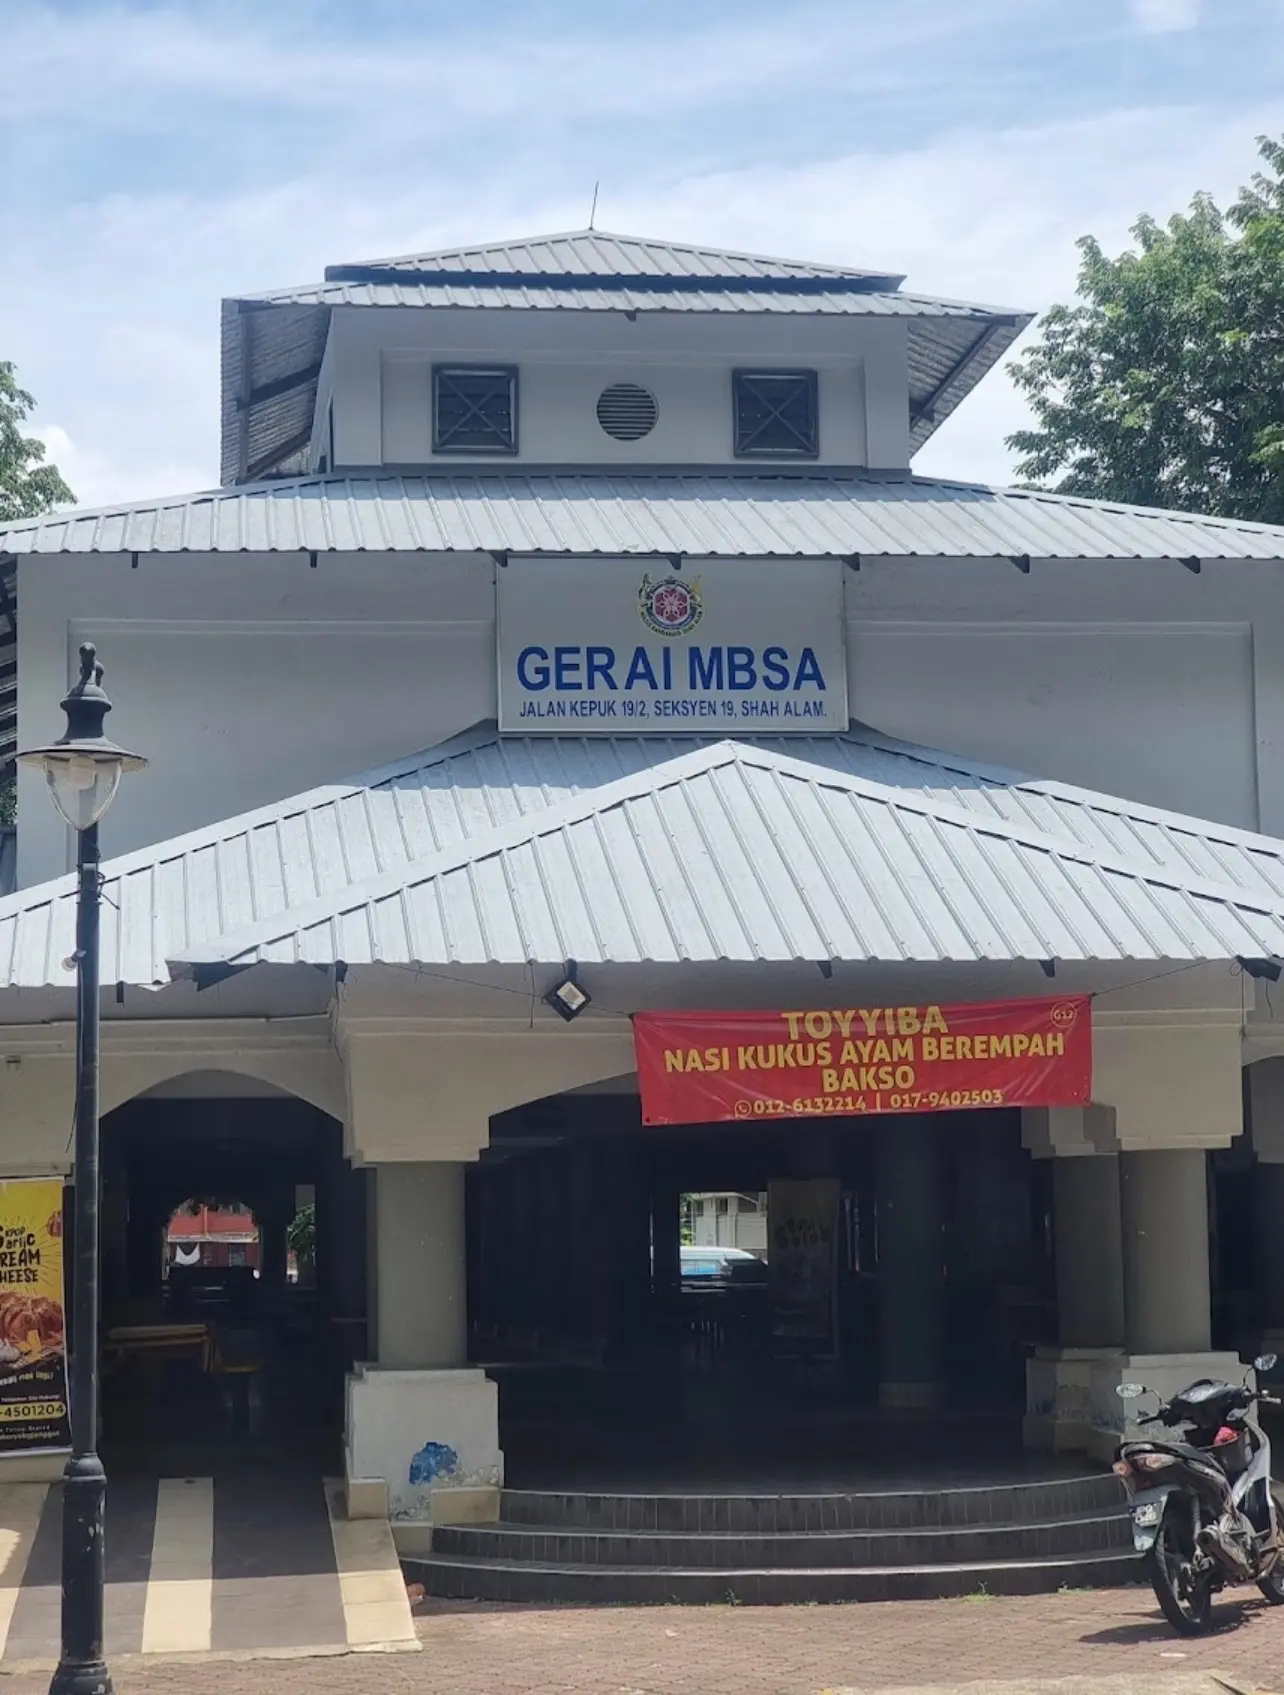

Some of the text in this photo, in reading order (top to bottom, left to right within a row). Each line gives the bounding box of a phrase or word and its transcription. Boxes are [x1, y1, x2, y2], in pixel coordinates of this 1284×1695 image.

[516, 645, 827, 692] GERAI MBSA
[519, 700, 828, 720] JALAN KEPUK 19/2, SEKSYEN 19, SHAH ALAM.
[781, 1005, 949, 1041] TOYYIBA
[664, 1032, 1065, 1074] NASI KUKUS AYAM BEREMPAH
[822, 1065, 915, 1093] BAKSO
[754, 1096, 867, 1115] 012-6132214
[890, 1089, 1004, 1108] 017-9402503
